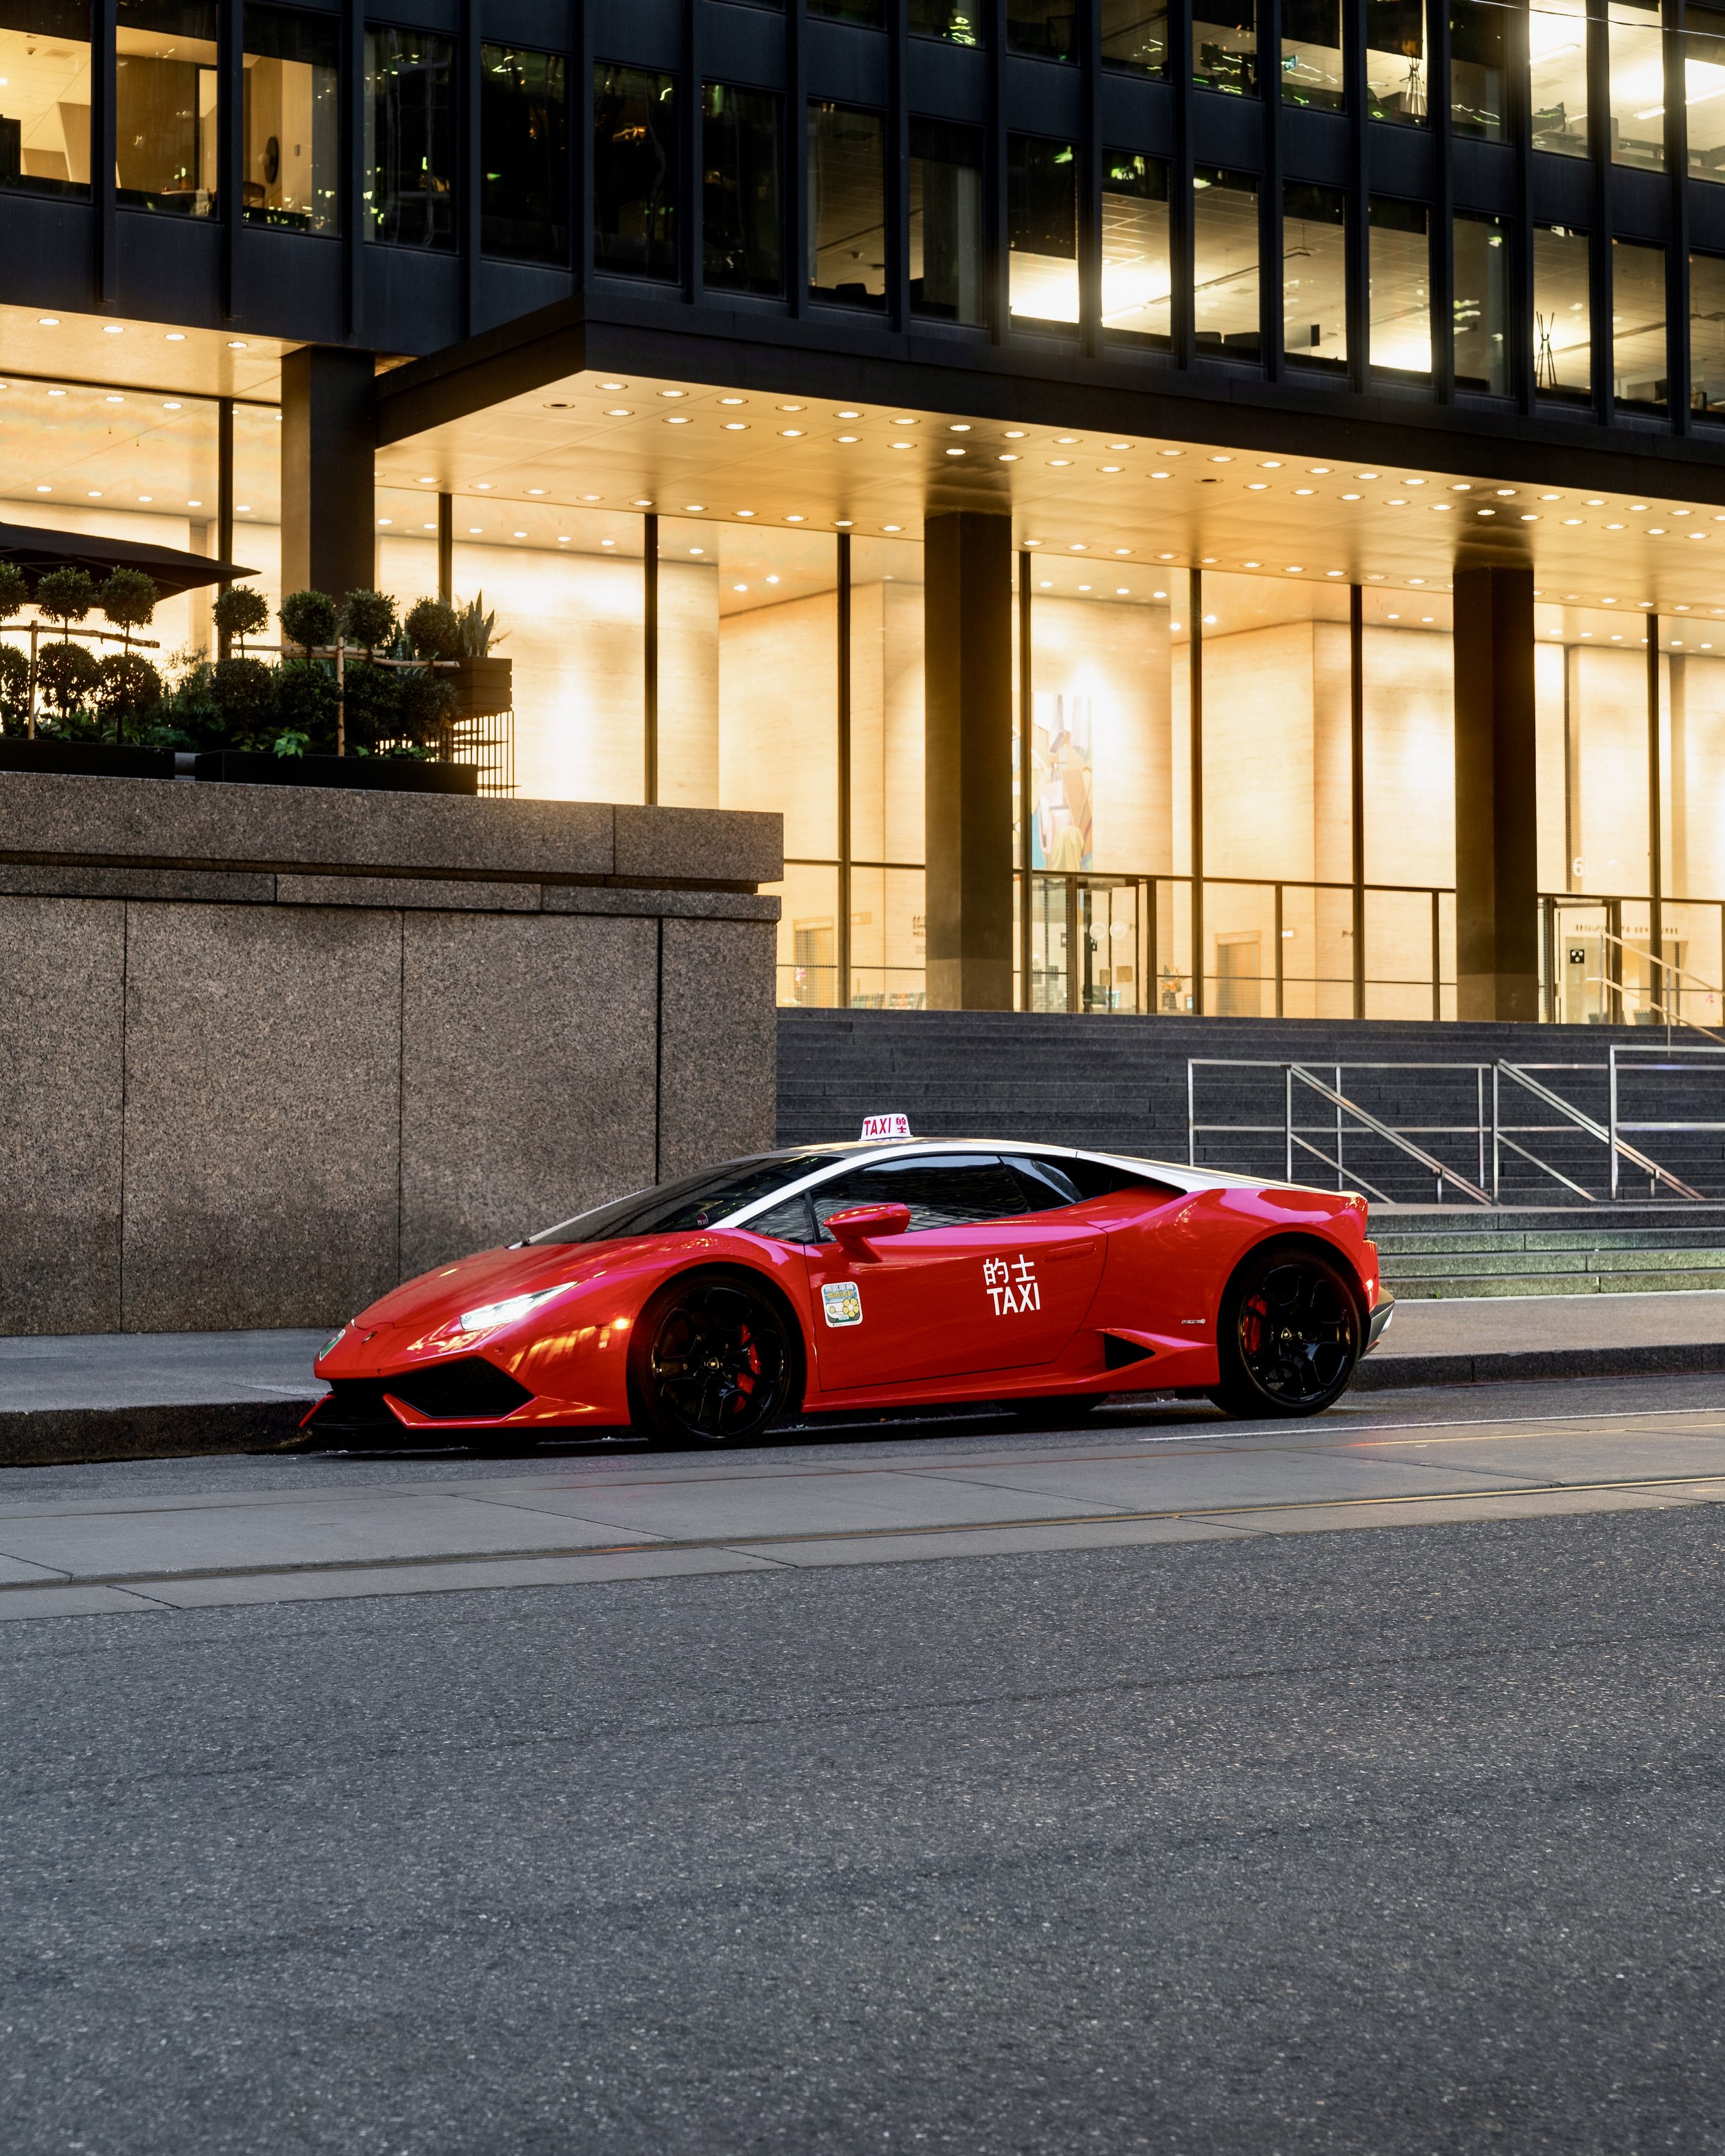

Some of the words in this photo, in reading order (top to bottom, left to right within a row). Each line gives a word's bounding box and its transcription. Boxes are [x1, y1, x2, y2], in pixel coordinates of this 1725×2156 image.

[864, 1118, 891, 1136] TAXI
[896, 1117, 907, 1134] 的士
[983, 1254, 1036, 1286] 的士
[986, 1283, 1041, 1316] TAXI
